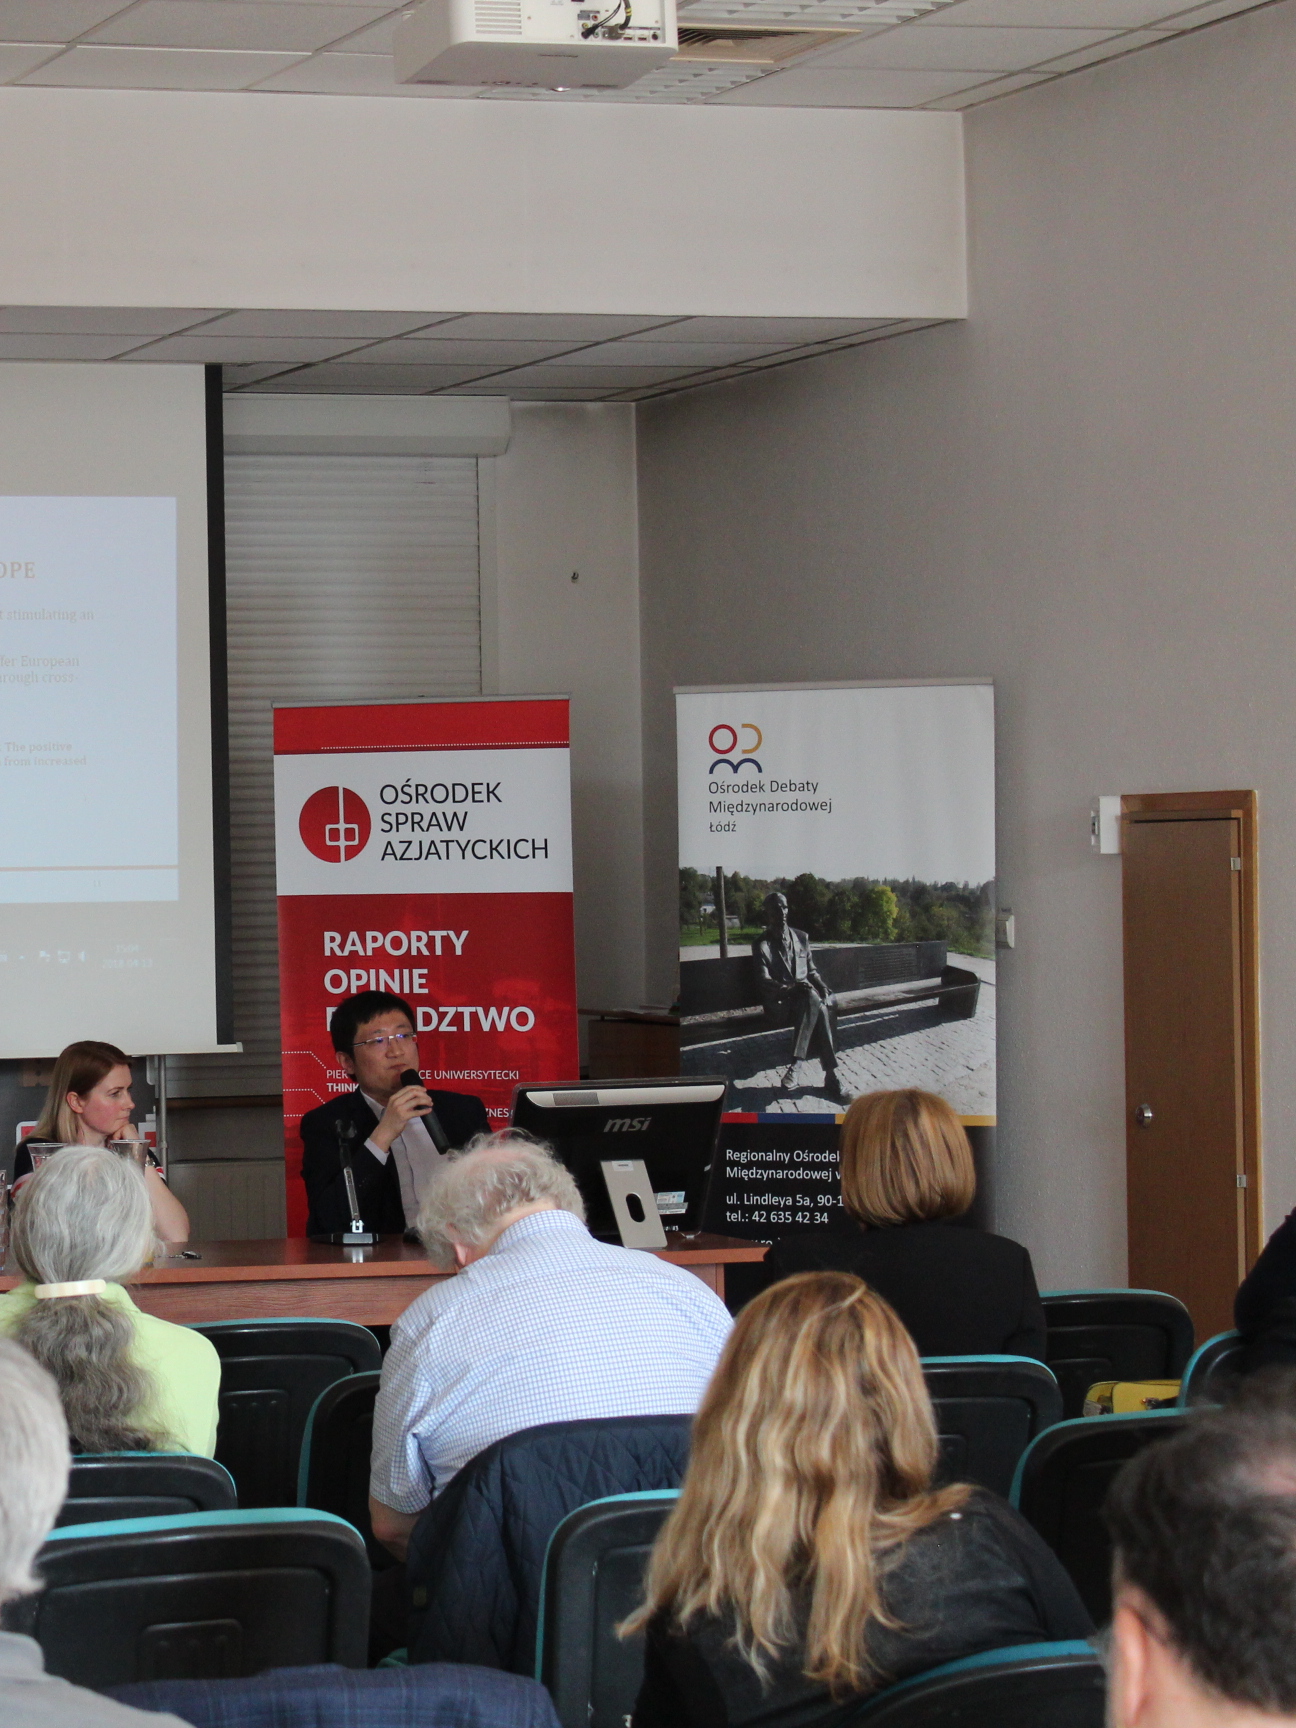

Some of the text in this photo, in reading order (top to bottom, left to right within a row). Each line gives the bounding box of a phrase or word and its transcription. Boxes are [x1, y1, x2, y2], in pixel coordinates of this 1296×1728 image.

[6, 608, 77, 623] stimulating
[79, 611, 94, 620] an
[20, 655, 79, 669] European
[5, 743, 25, 753] The
[28, 742, 72, 755] positive
[3, 757, 31, 767] from
[33, 756, 86, 767] increased
[380, 778, 502, 805] OŚRODEK
[708, 780, 819, 794] Ośrodek Debaty
[709, 798, 832, 816] Międzynarodowej
[380, 811, 468, 832] SPRAW
[709, 821, 737, 833] Łódź
[381, 838, 549, 861] AZJATYCKICH
[324, 930, 470, 956] RAPORTY
[324, 968, 429, 994] OPINIE
[326, 1006, 535, 1033] DZTWO
[434, 1070, 519, 1080] UNIWERSYTECKI
[603, 1116, 652, 1133] msi
[726, 1149, 790, 1163] Regionalny
[726, 1167, 832, 1182] Międzynarodowej
[726, 1193, 844, 1208] ul. Lindleya 5a, 90-1
[726, 1210, 829, 1224] tel.: 42 635 42 34
